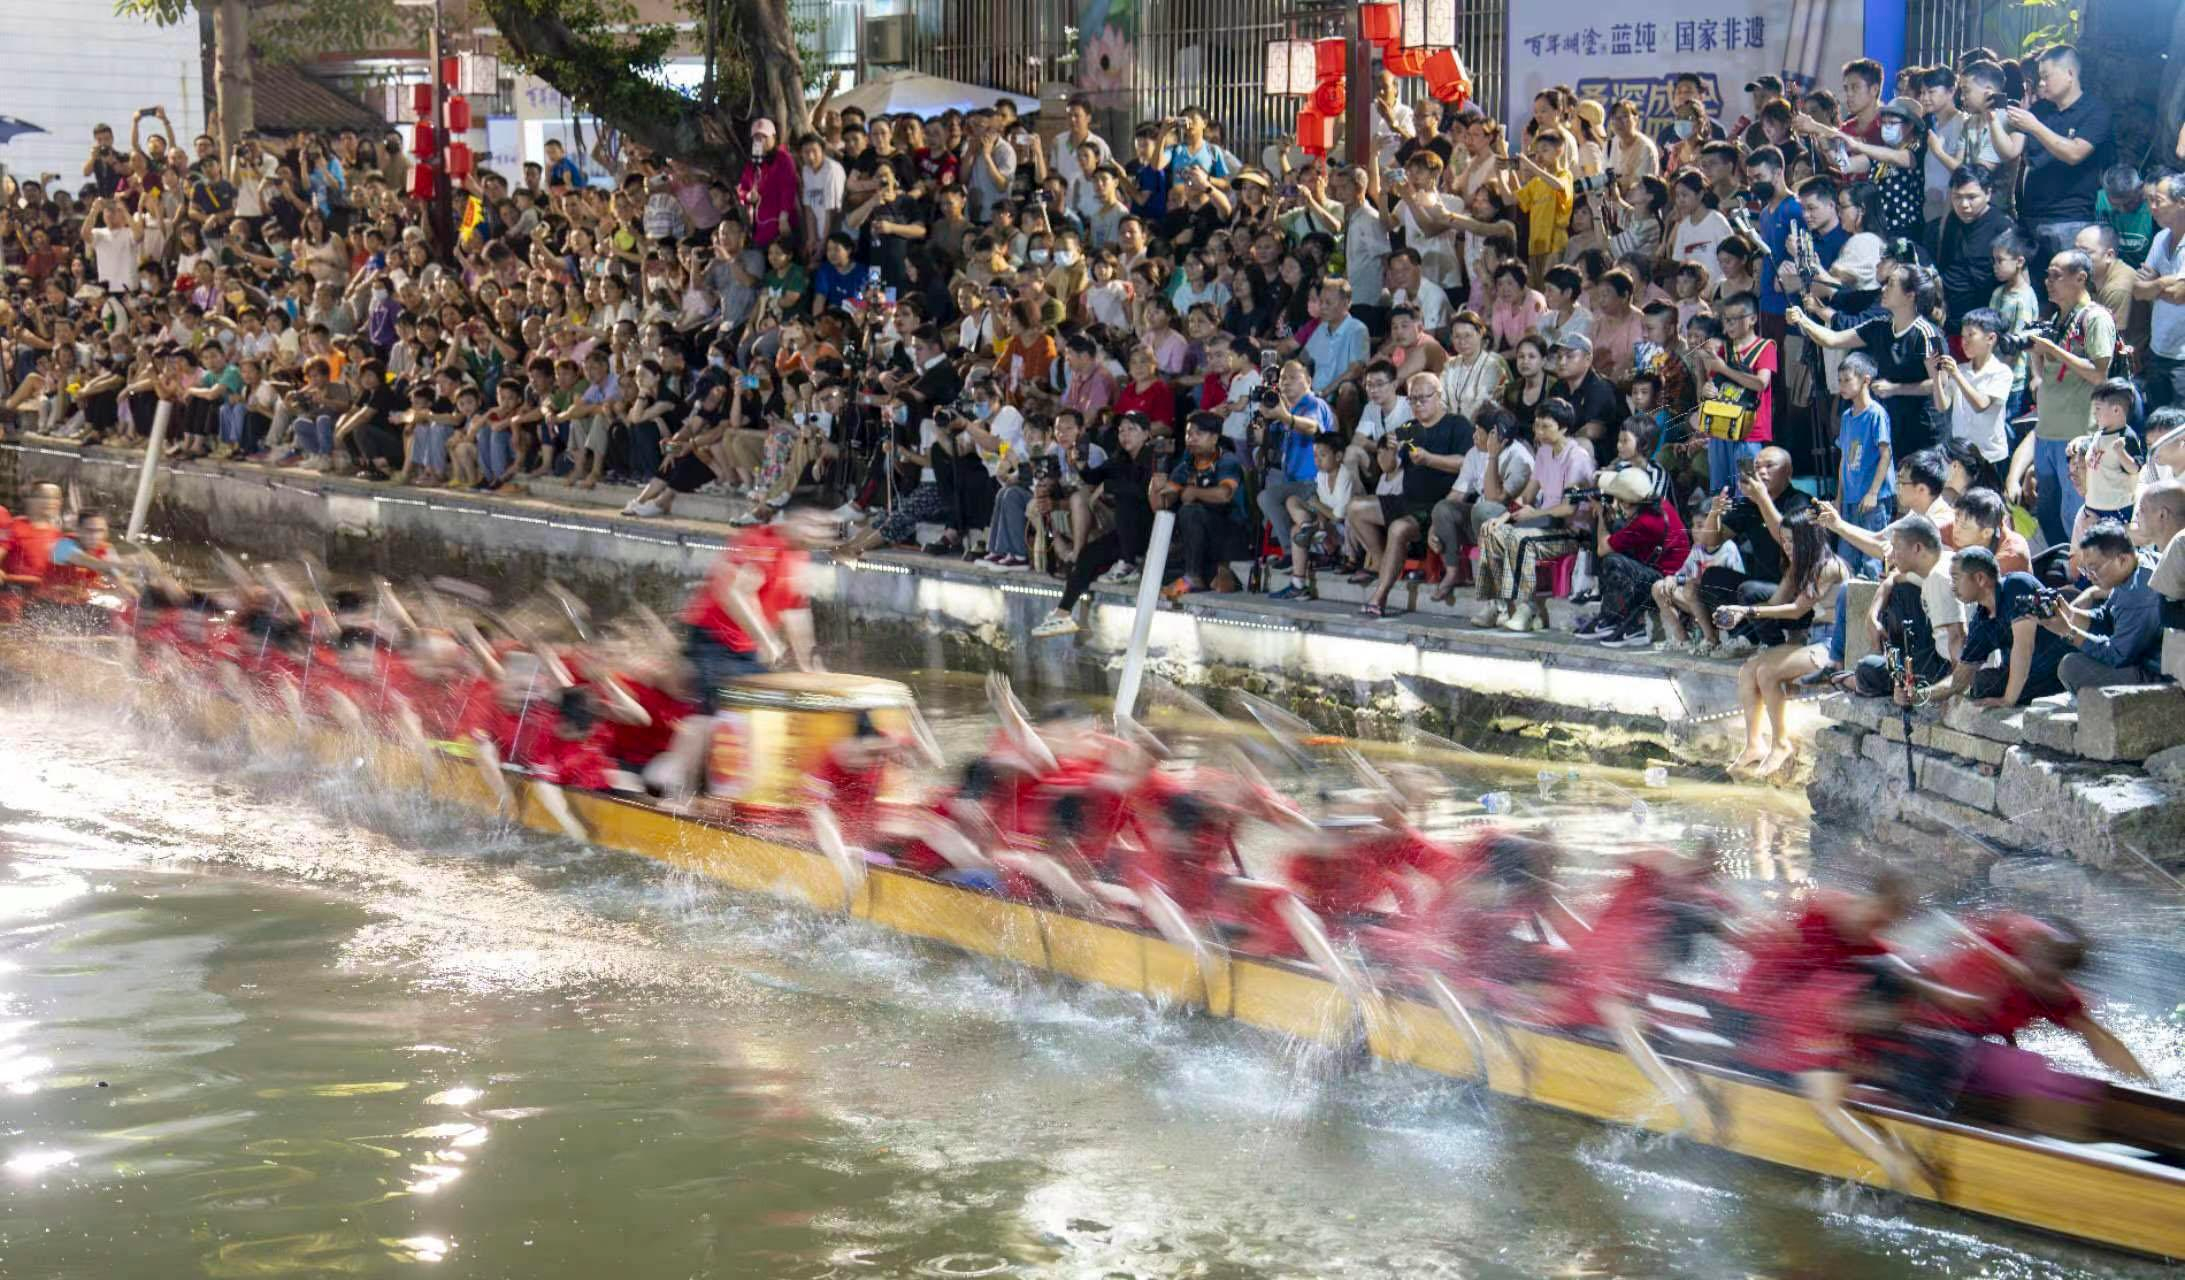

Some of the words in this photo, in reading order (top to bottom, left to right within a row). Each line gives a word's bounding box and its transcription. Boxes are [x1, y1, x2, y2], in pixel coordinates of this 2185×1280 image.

[1611, 22, 1656, 54] 蓝纯
[1675, 16, 1764, 53] 国家非遗
